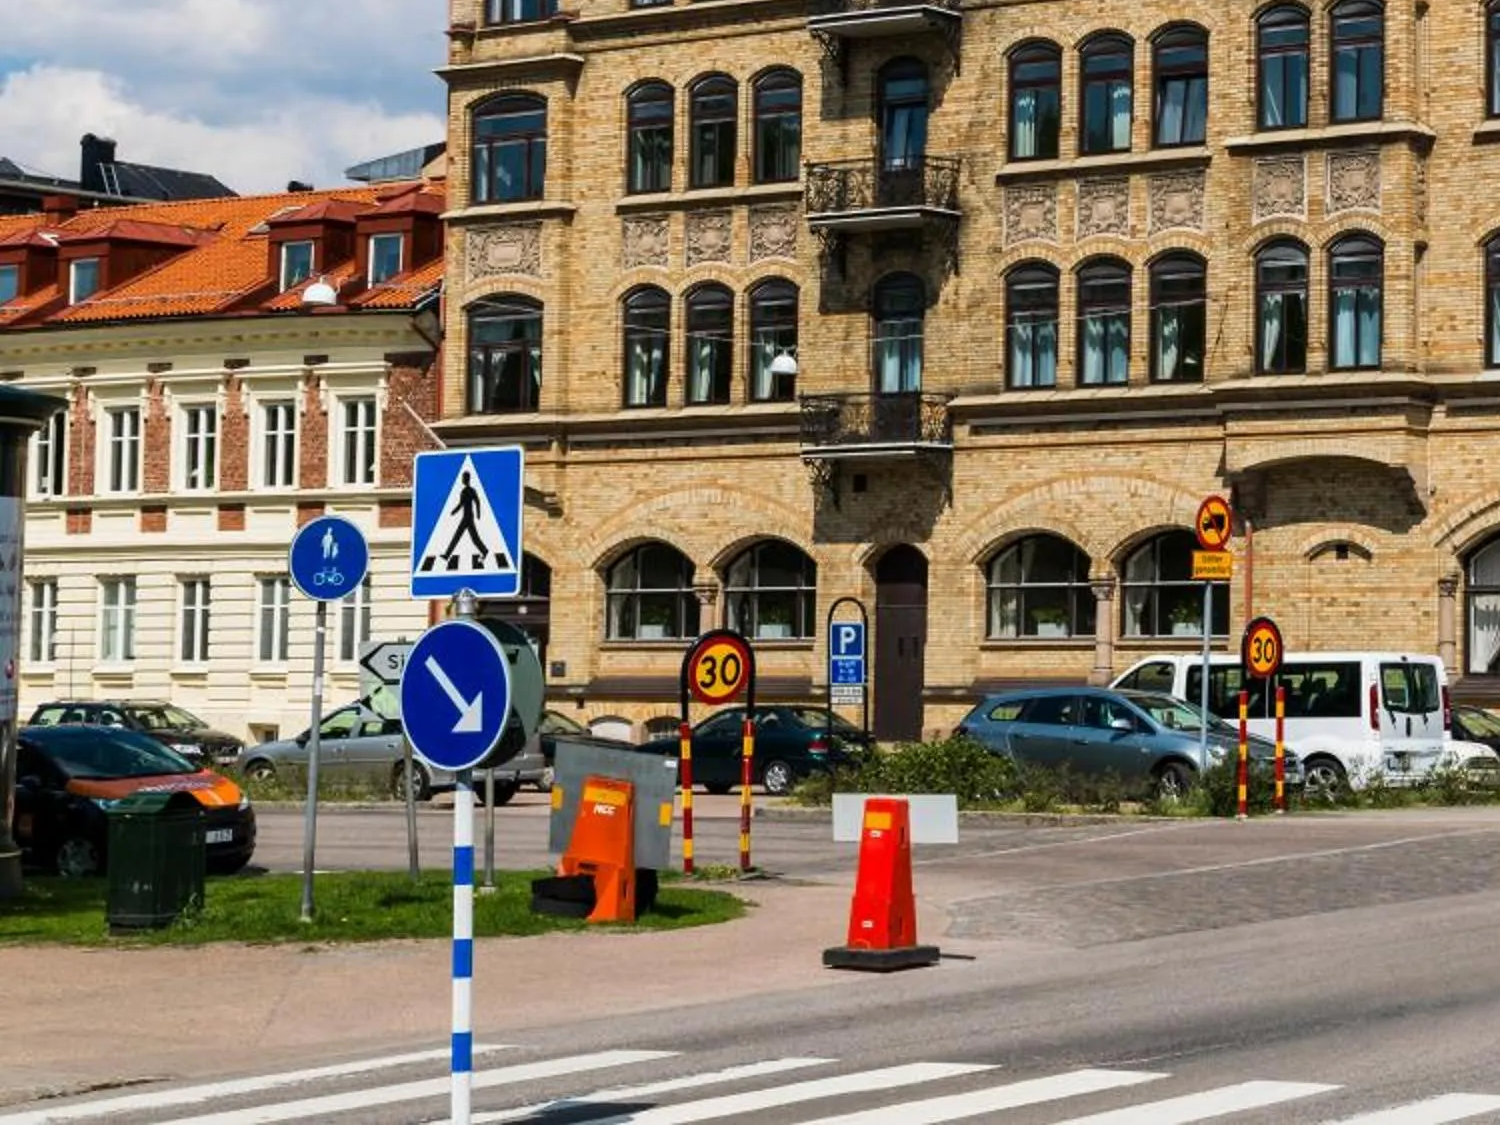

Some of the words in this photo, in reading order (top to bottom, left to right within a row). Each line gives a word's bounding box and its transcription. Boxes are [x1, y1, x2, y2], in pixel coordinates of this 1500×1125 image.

[840, 626, 857, 654] P
[1253, 636, 1275, 664] 30
[700, 653, 741, 689] 30
